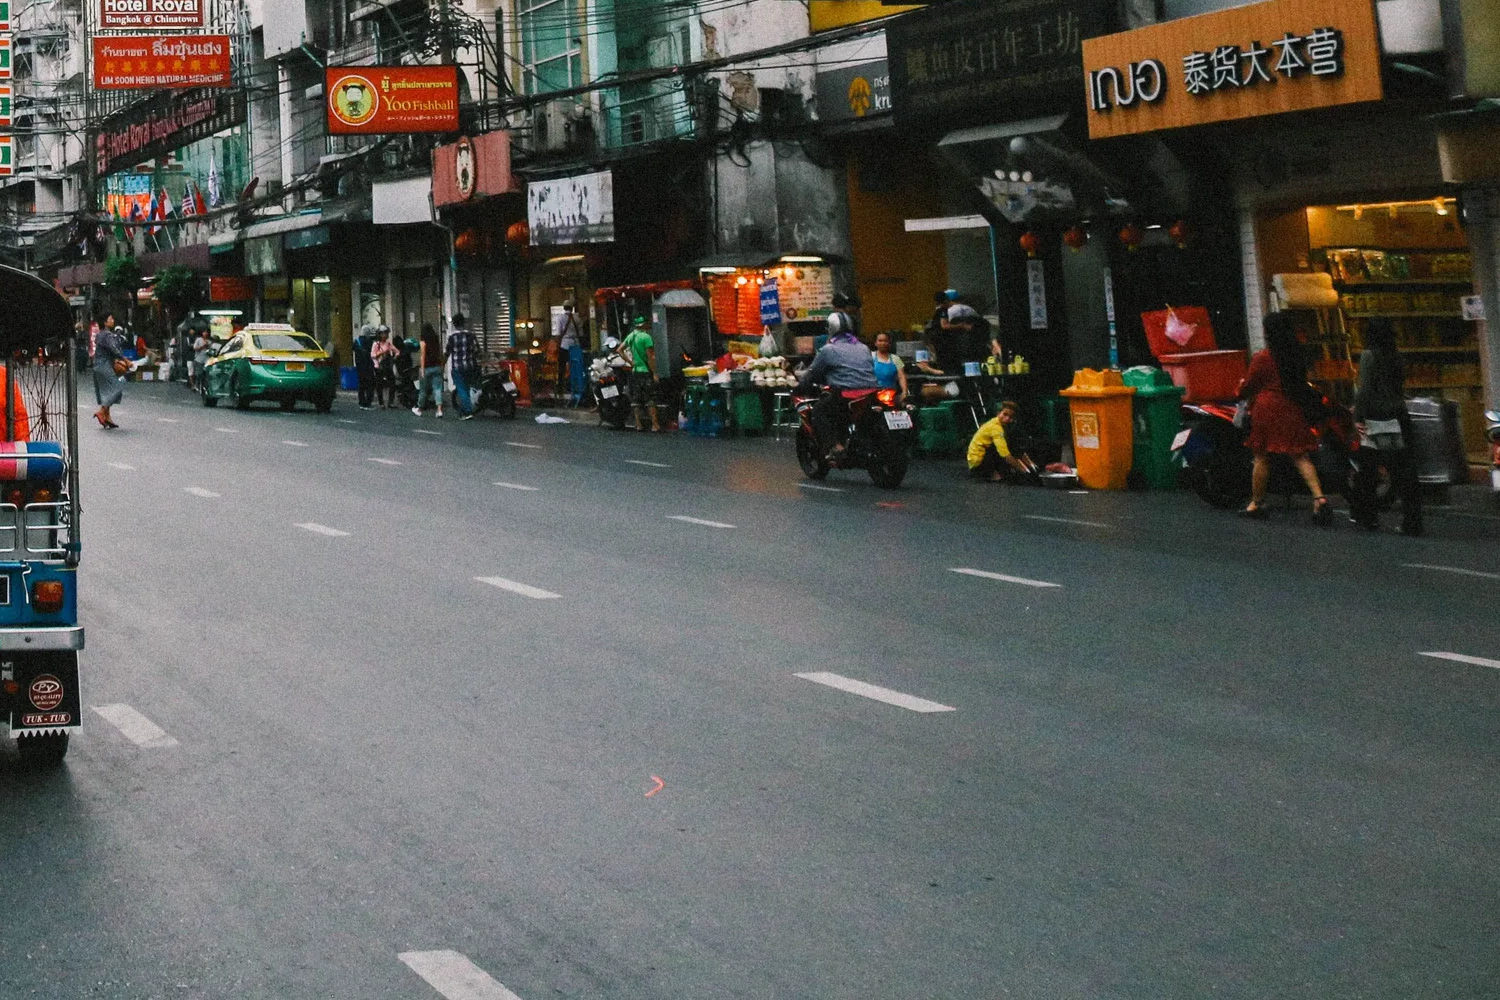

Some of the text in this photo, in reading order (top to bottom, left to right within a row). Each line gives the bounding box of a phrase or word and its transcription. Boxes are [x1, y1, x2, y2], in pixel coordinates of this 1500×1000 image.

[105, 14, 141, 25] Bangkok
[154, 14, 198, 23] Chinatown
[1183, 28, 1338, 94] 泰货大本营
[101, 73, 223, 85] LIM SOON HENG NATURAL MEDICINE
[413, 101, 454, 111] Fishball
[26, 715, 43, 723] TUK
[49, 714, 67, 722] TUK
